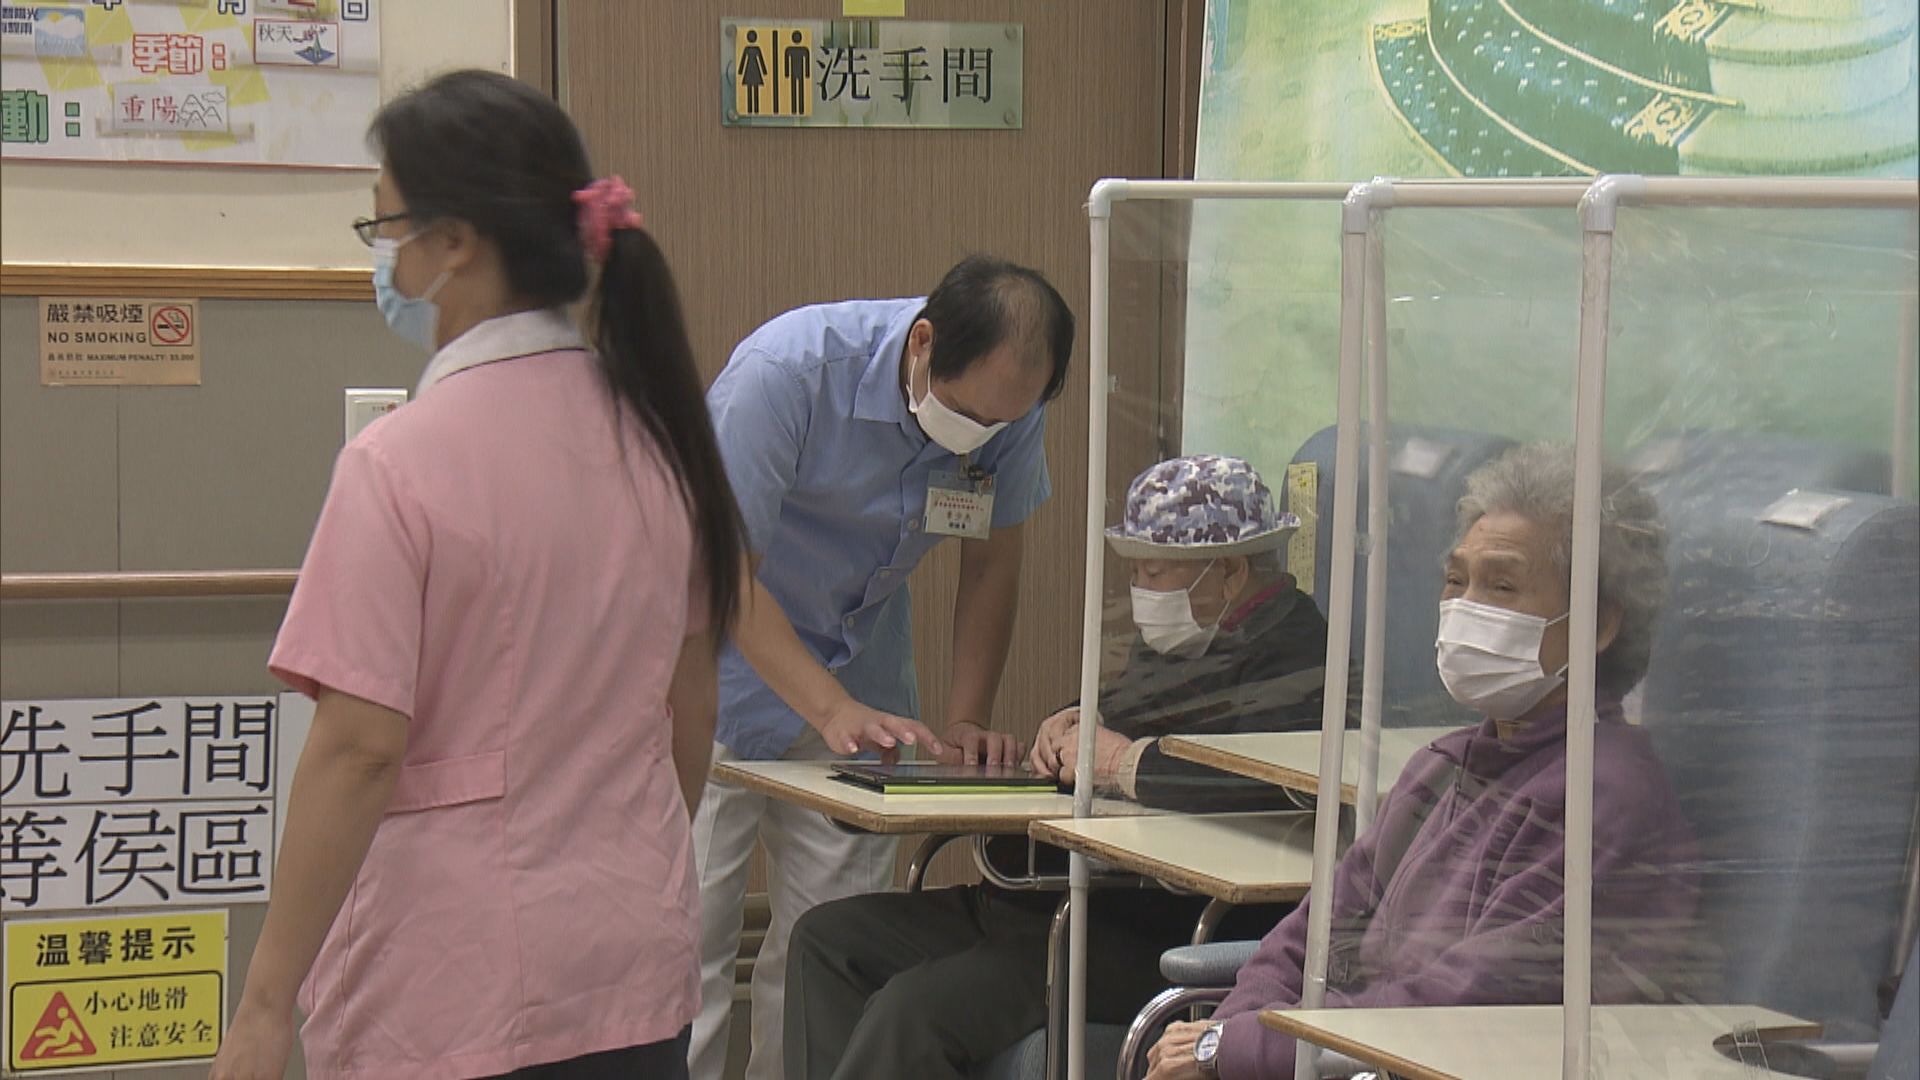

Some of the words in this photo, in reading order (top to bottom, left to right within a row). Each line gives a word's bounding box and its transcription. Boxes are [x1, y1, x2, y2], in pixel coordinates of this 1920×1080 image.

[258, 24, 292, 43] 秋天
[816, 46, 993, 103] 洗手間
[120, 95, 177, 124] 重陽
[47, 303, 144, 323] 嚴禁吸煙
[48, 332, 69, 343] NO
[75, 332, 146, 344] SMOKING
[84, 986, 188, 1015] 小心地滑
[110, 1019, 213, 1049] 注意安全
